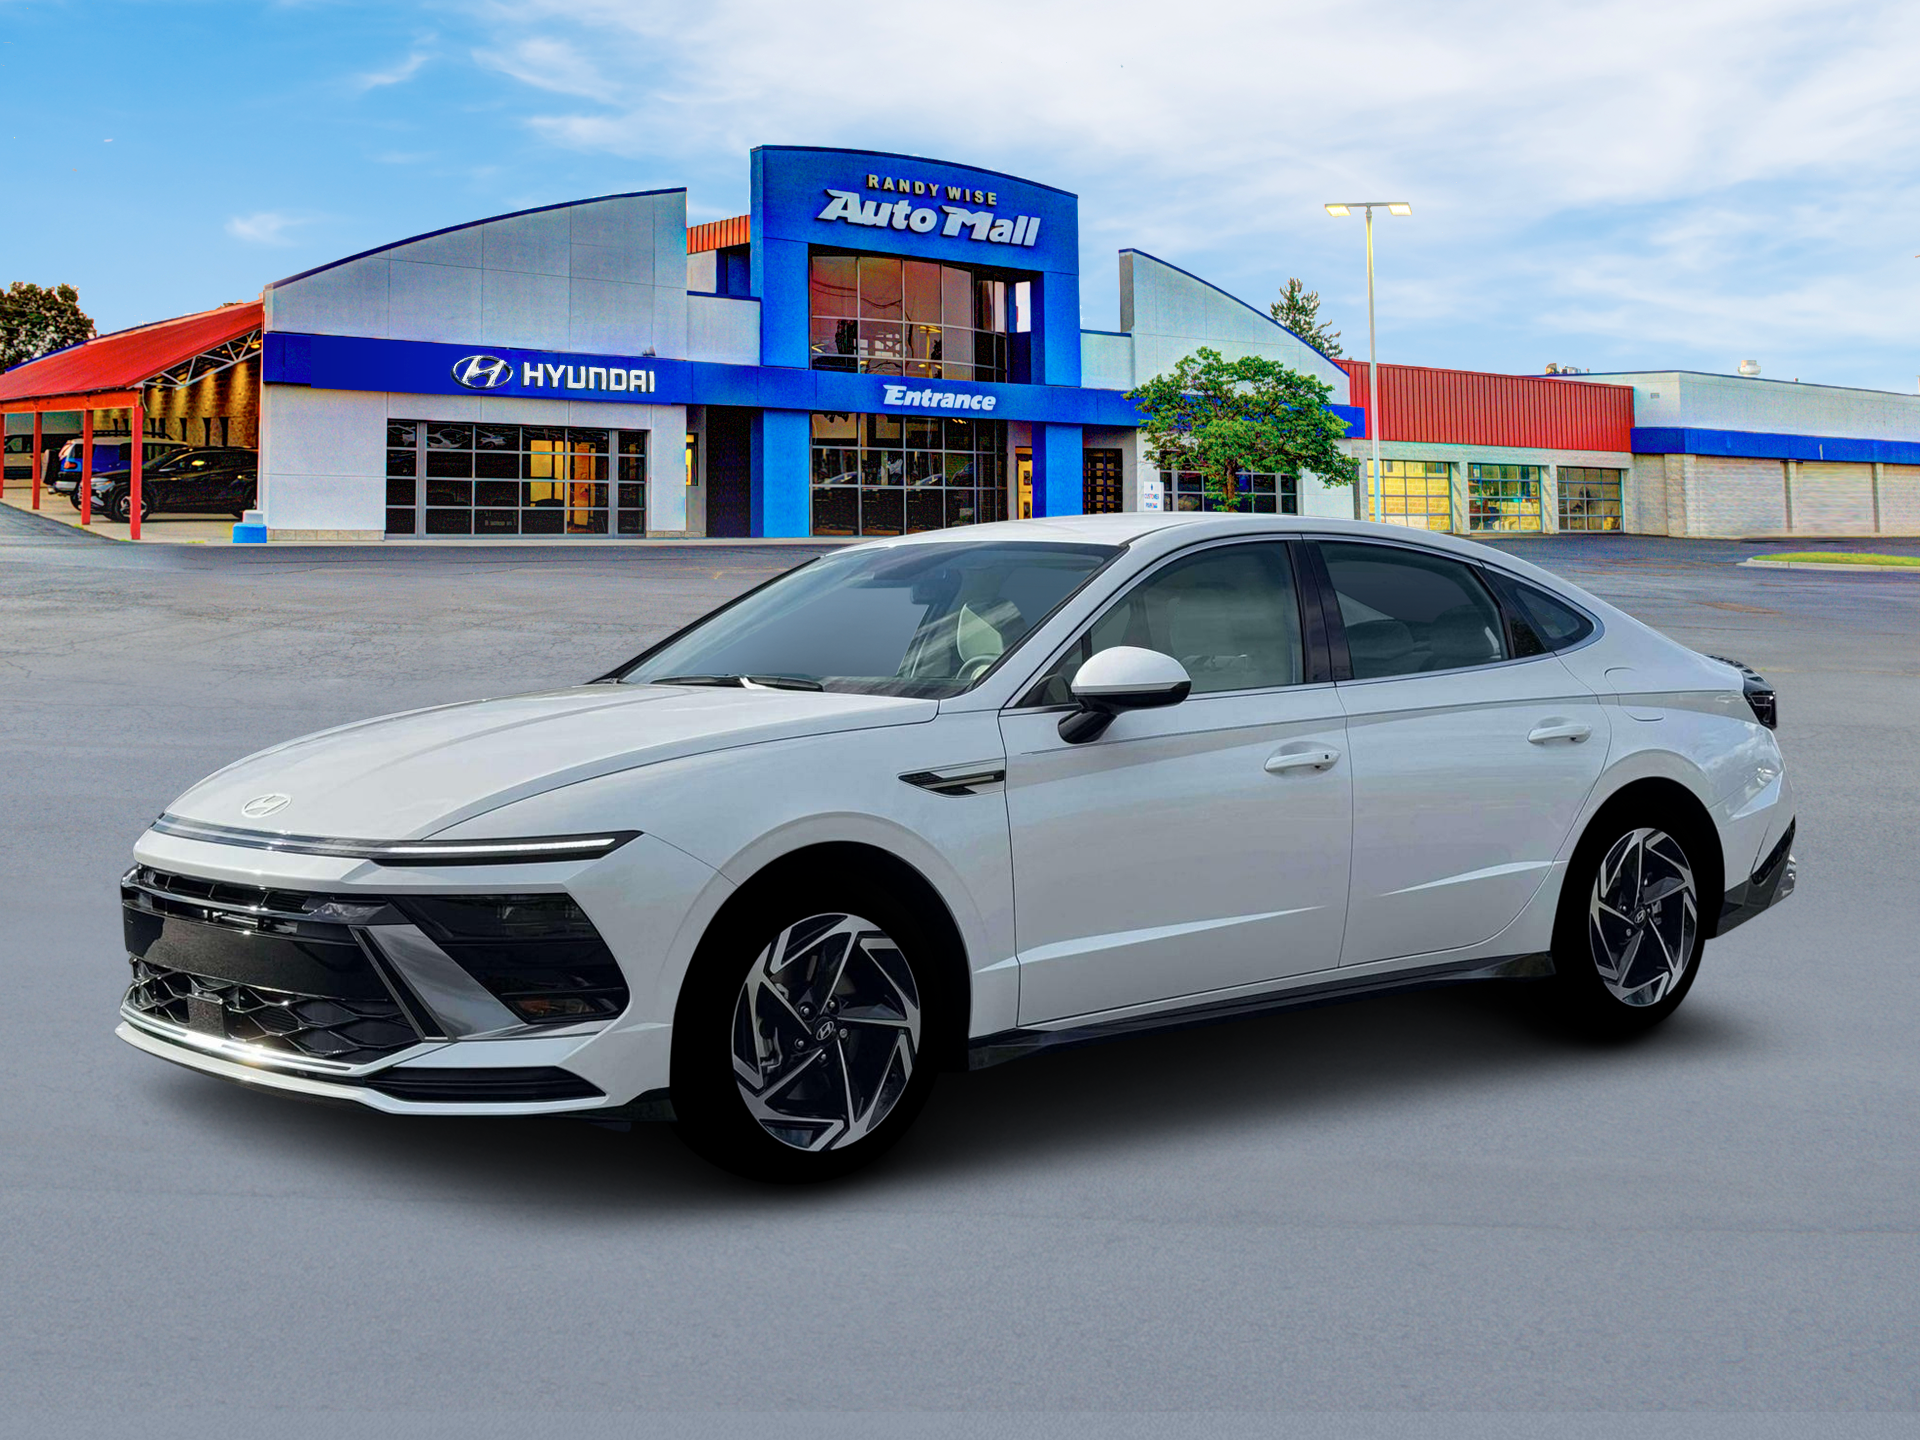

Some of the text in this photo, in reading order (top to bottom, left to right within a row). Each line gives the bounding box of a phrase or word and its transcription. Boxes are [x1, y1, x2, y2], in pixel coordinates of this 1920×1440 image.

[867, 174, 997, 205] RANDY WISE
[817, 188, 1041, 247] Auto Mall
[522, 362, 655, 393] HYUNDAI
[883, 385, 997, 411] Entrance
